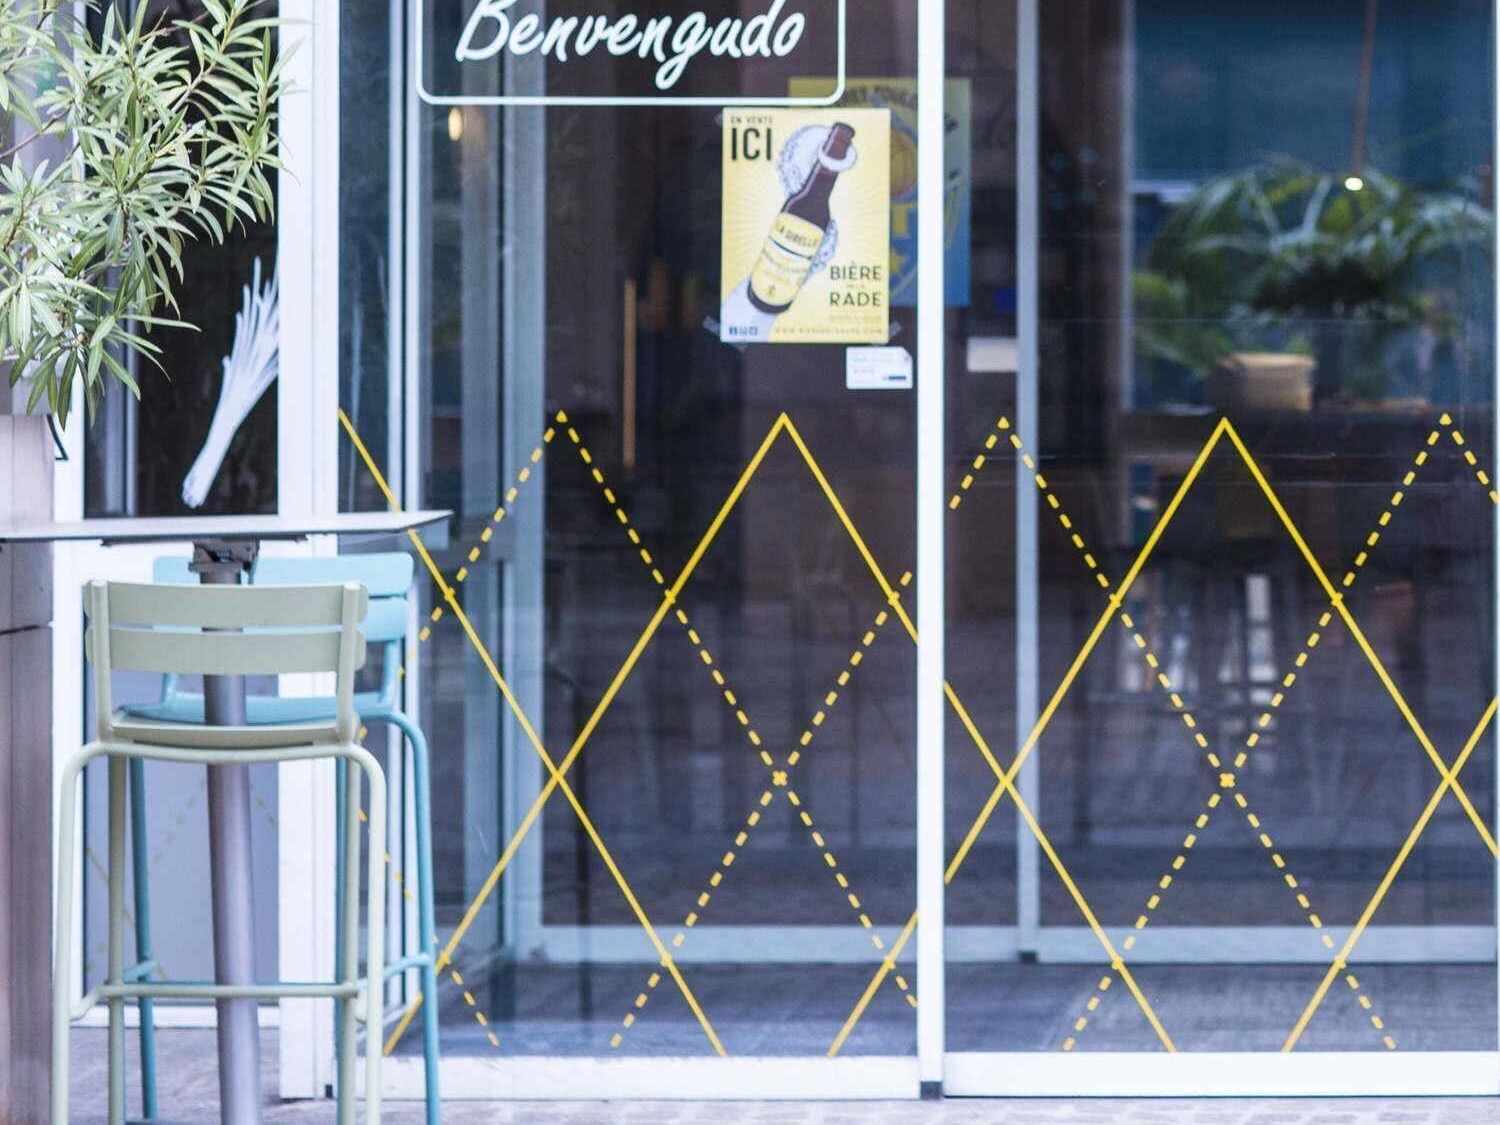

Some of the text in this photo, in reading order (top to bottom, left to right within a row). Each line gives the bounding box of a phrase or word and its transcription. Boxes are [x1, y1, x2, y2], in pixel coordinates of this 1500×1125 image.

[731, 127, 772, 161] ICI
[830, 260, 882, 281] BIÈRE
[829, 291, 882, 307] RADE
